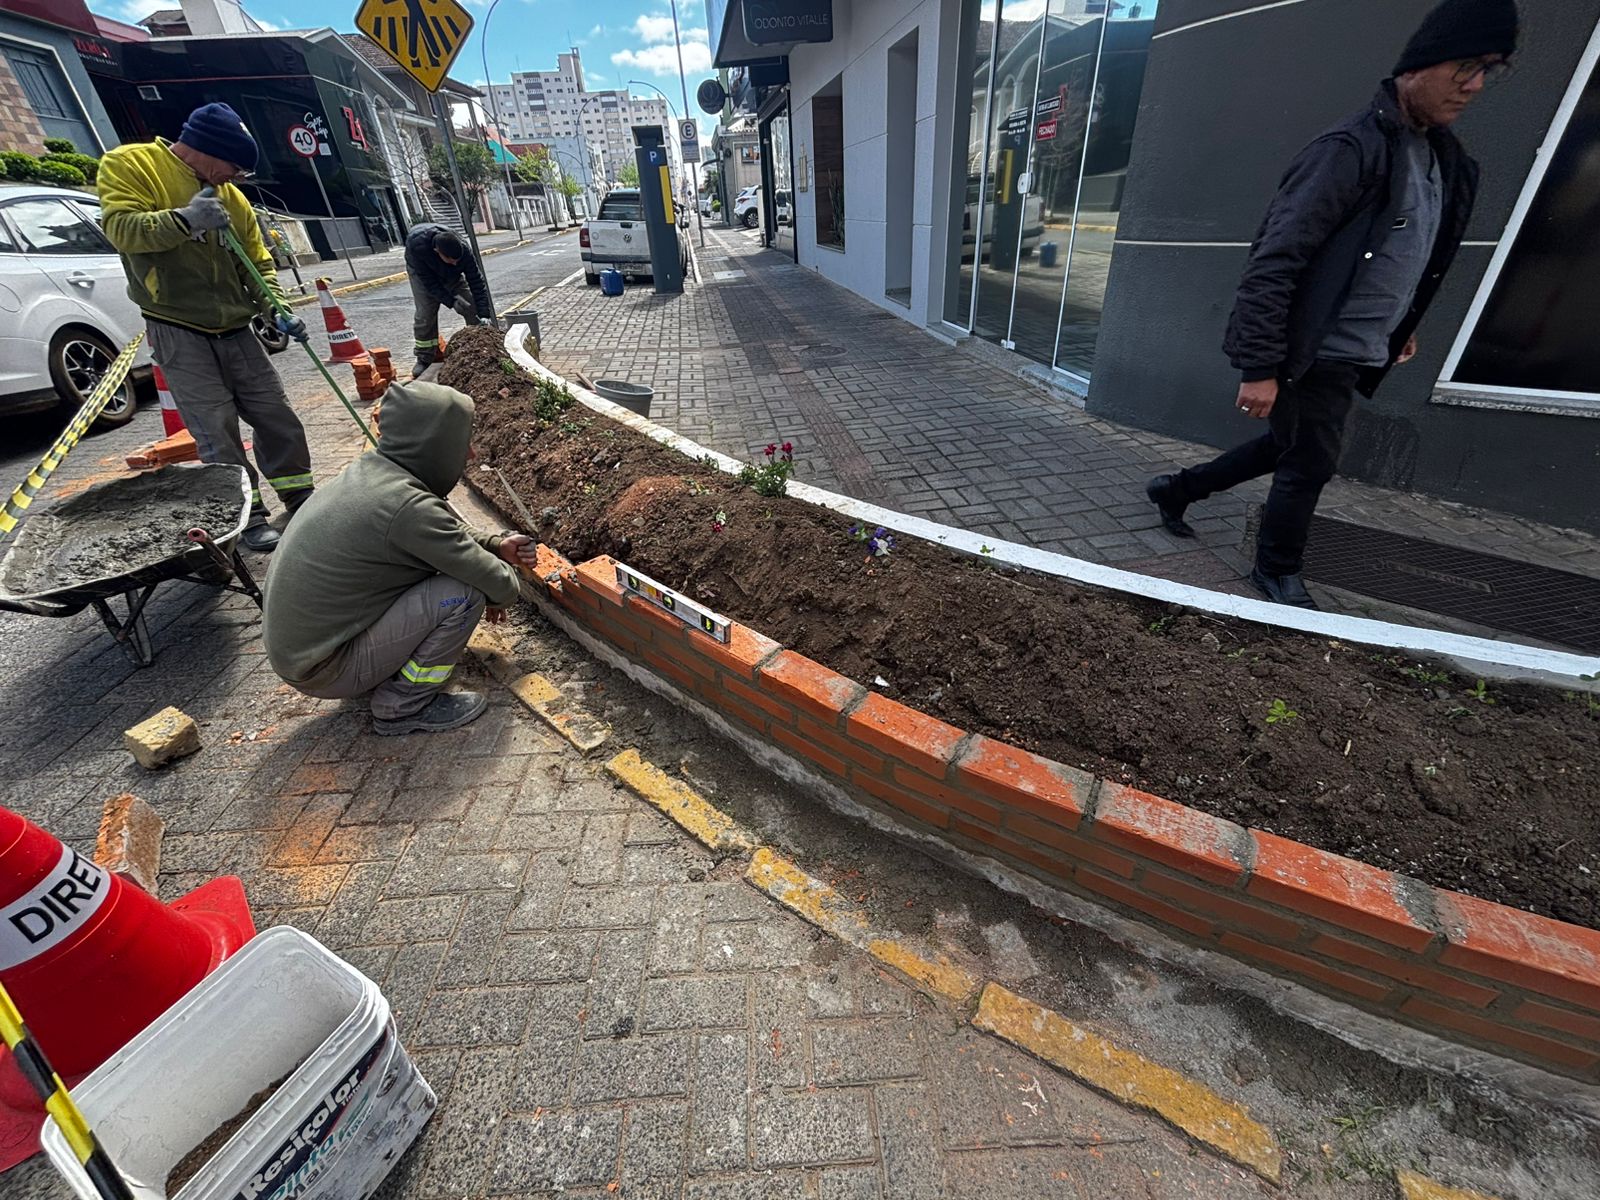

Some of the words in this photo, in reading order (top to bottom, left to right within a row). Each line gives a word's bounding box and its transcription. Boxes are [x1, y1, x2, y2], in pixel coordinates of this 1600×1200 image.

[755, 16, 795, 29] ODONTO
[797, 13, 828, 25] VITALLE
[685, 125, 692, 136] E
[294, 131, 313, 146] 40
[649, 151, 657, 162] P
